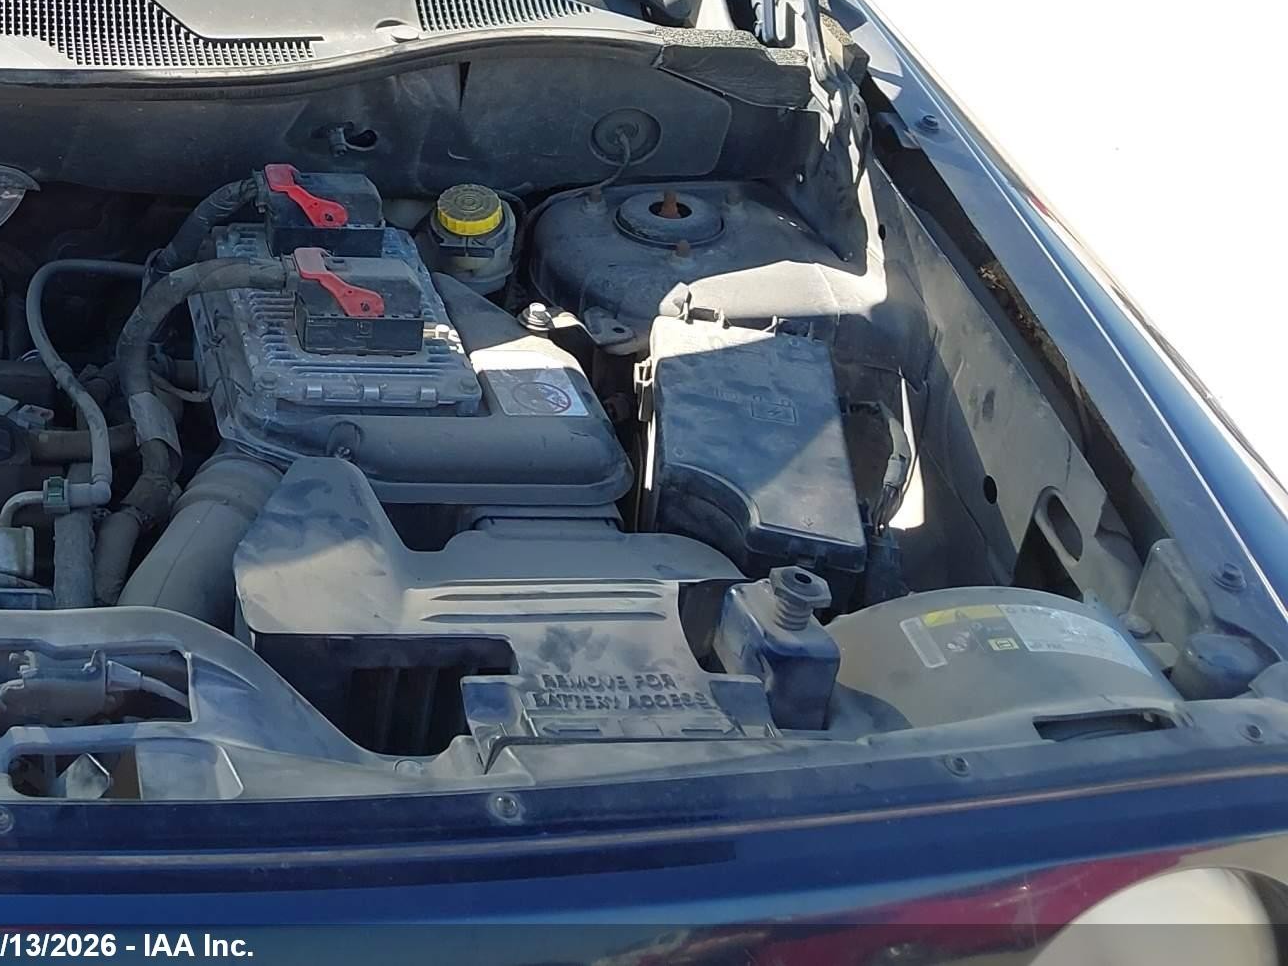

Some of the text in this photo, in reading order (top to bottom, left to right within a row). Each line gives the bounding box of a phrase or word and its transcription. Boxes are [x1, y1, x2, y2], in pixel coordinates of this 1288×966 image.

[540, 673, 679, 692] REMOVE FOR
[531, 690, 717, 711] BATTERY ACCESS
